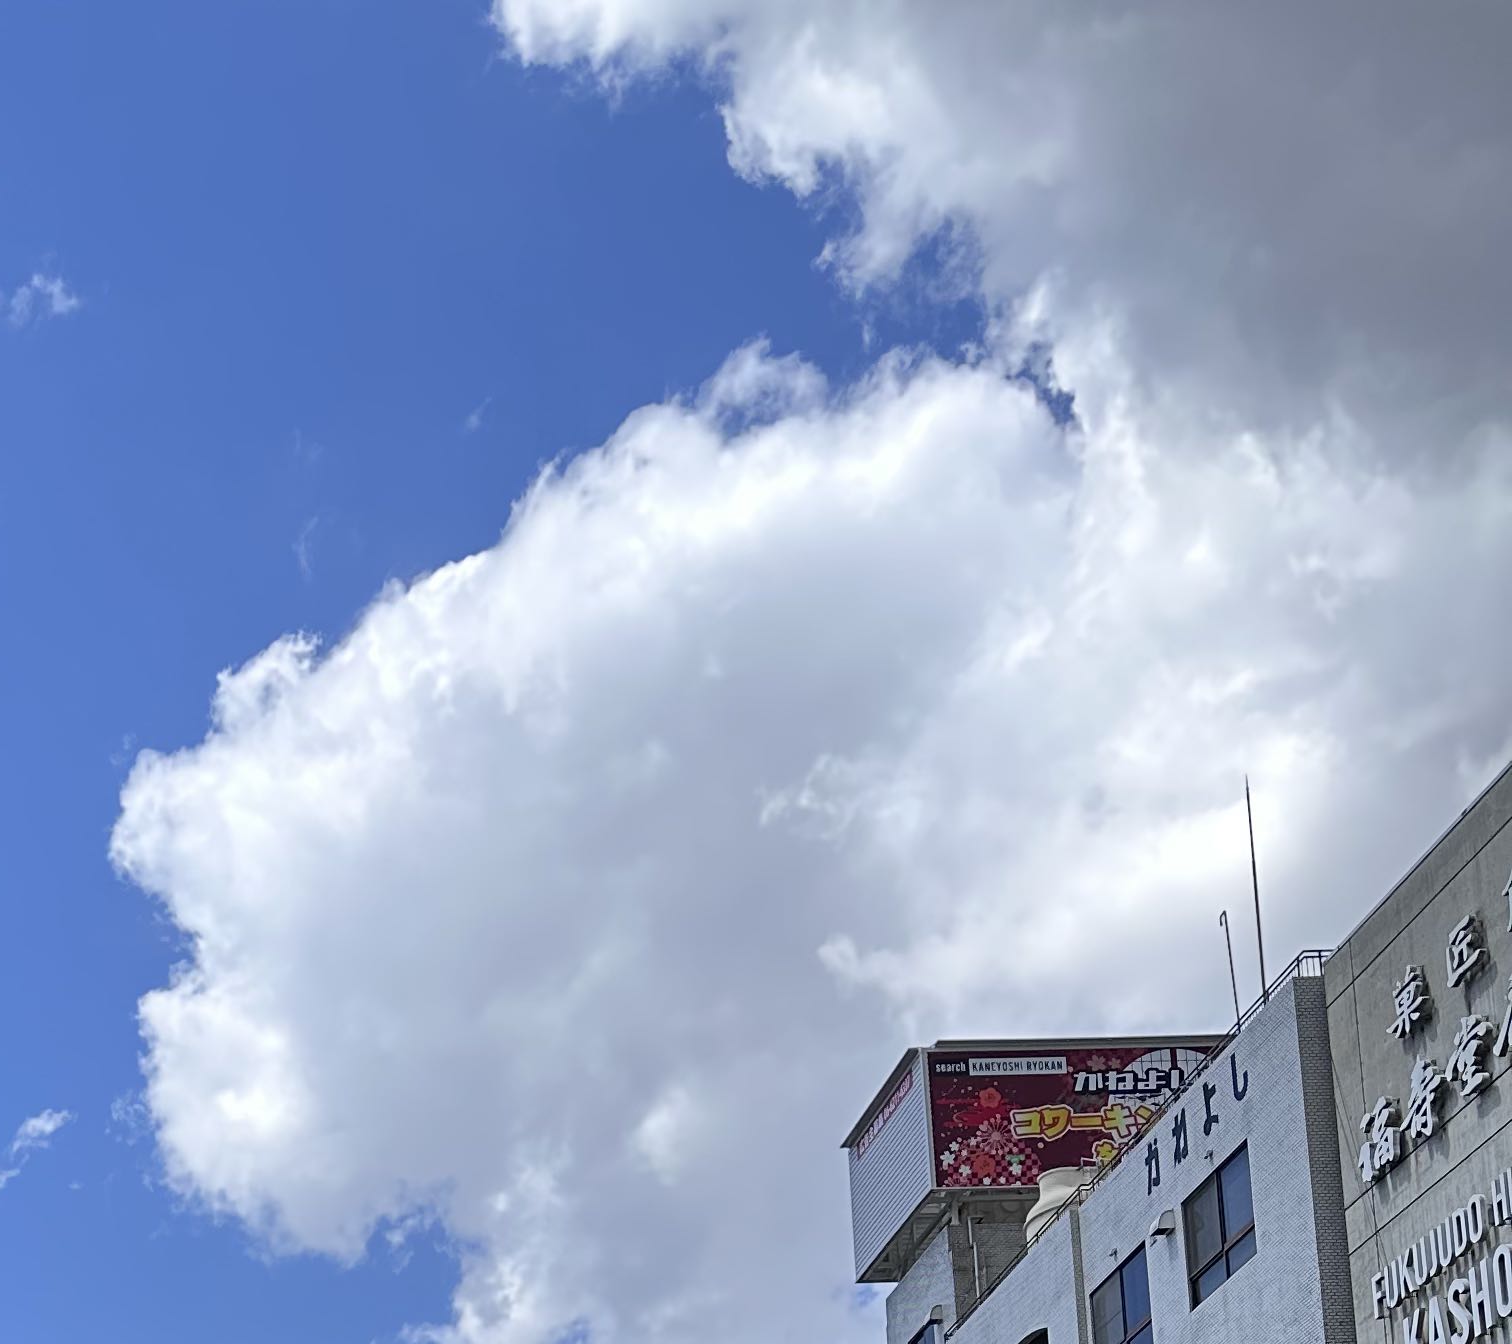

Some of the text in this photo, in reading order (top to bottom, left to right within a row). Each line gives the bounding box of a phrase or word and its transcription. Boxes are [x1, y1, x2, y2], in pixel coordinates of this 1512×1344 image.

[1386, 870, 1512, 1038] 菓匠
[935, 1059, 1063, 1073] search KANEYOSHI RYOKAN
[1146, 1052, 1249, 1195] かねよし
[1370, 1193, 1488, 1320] FUKUJUDO
